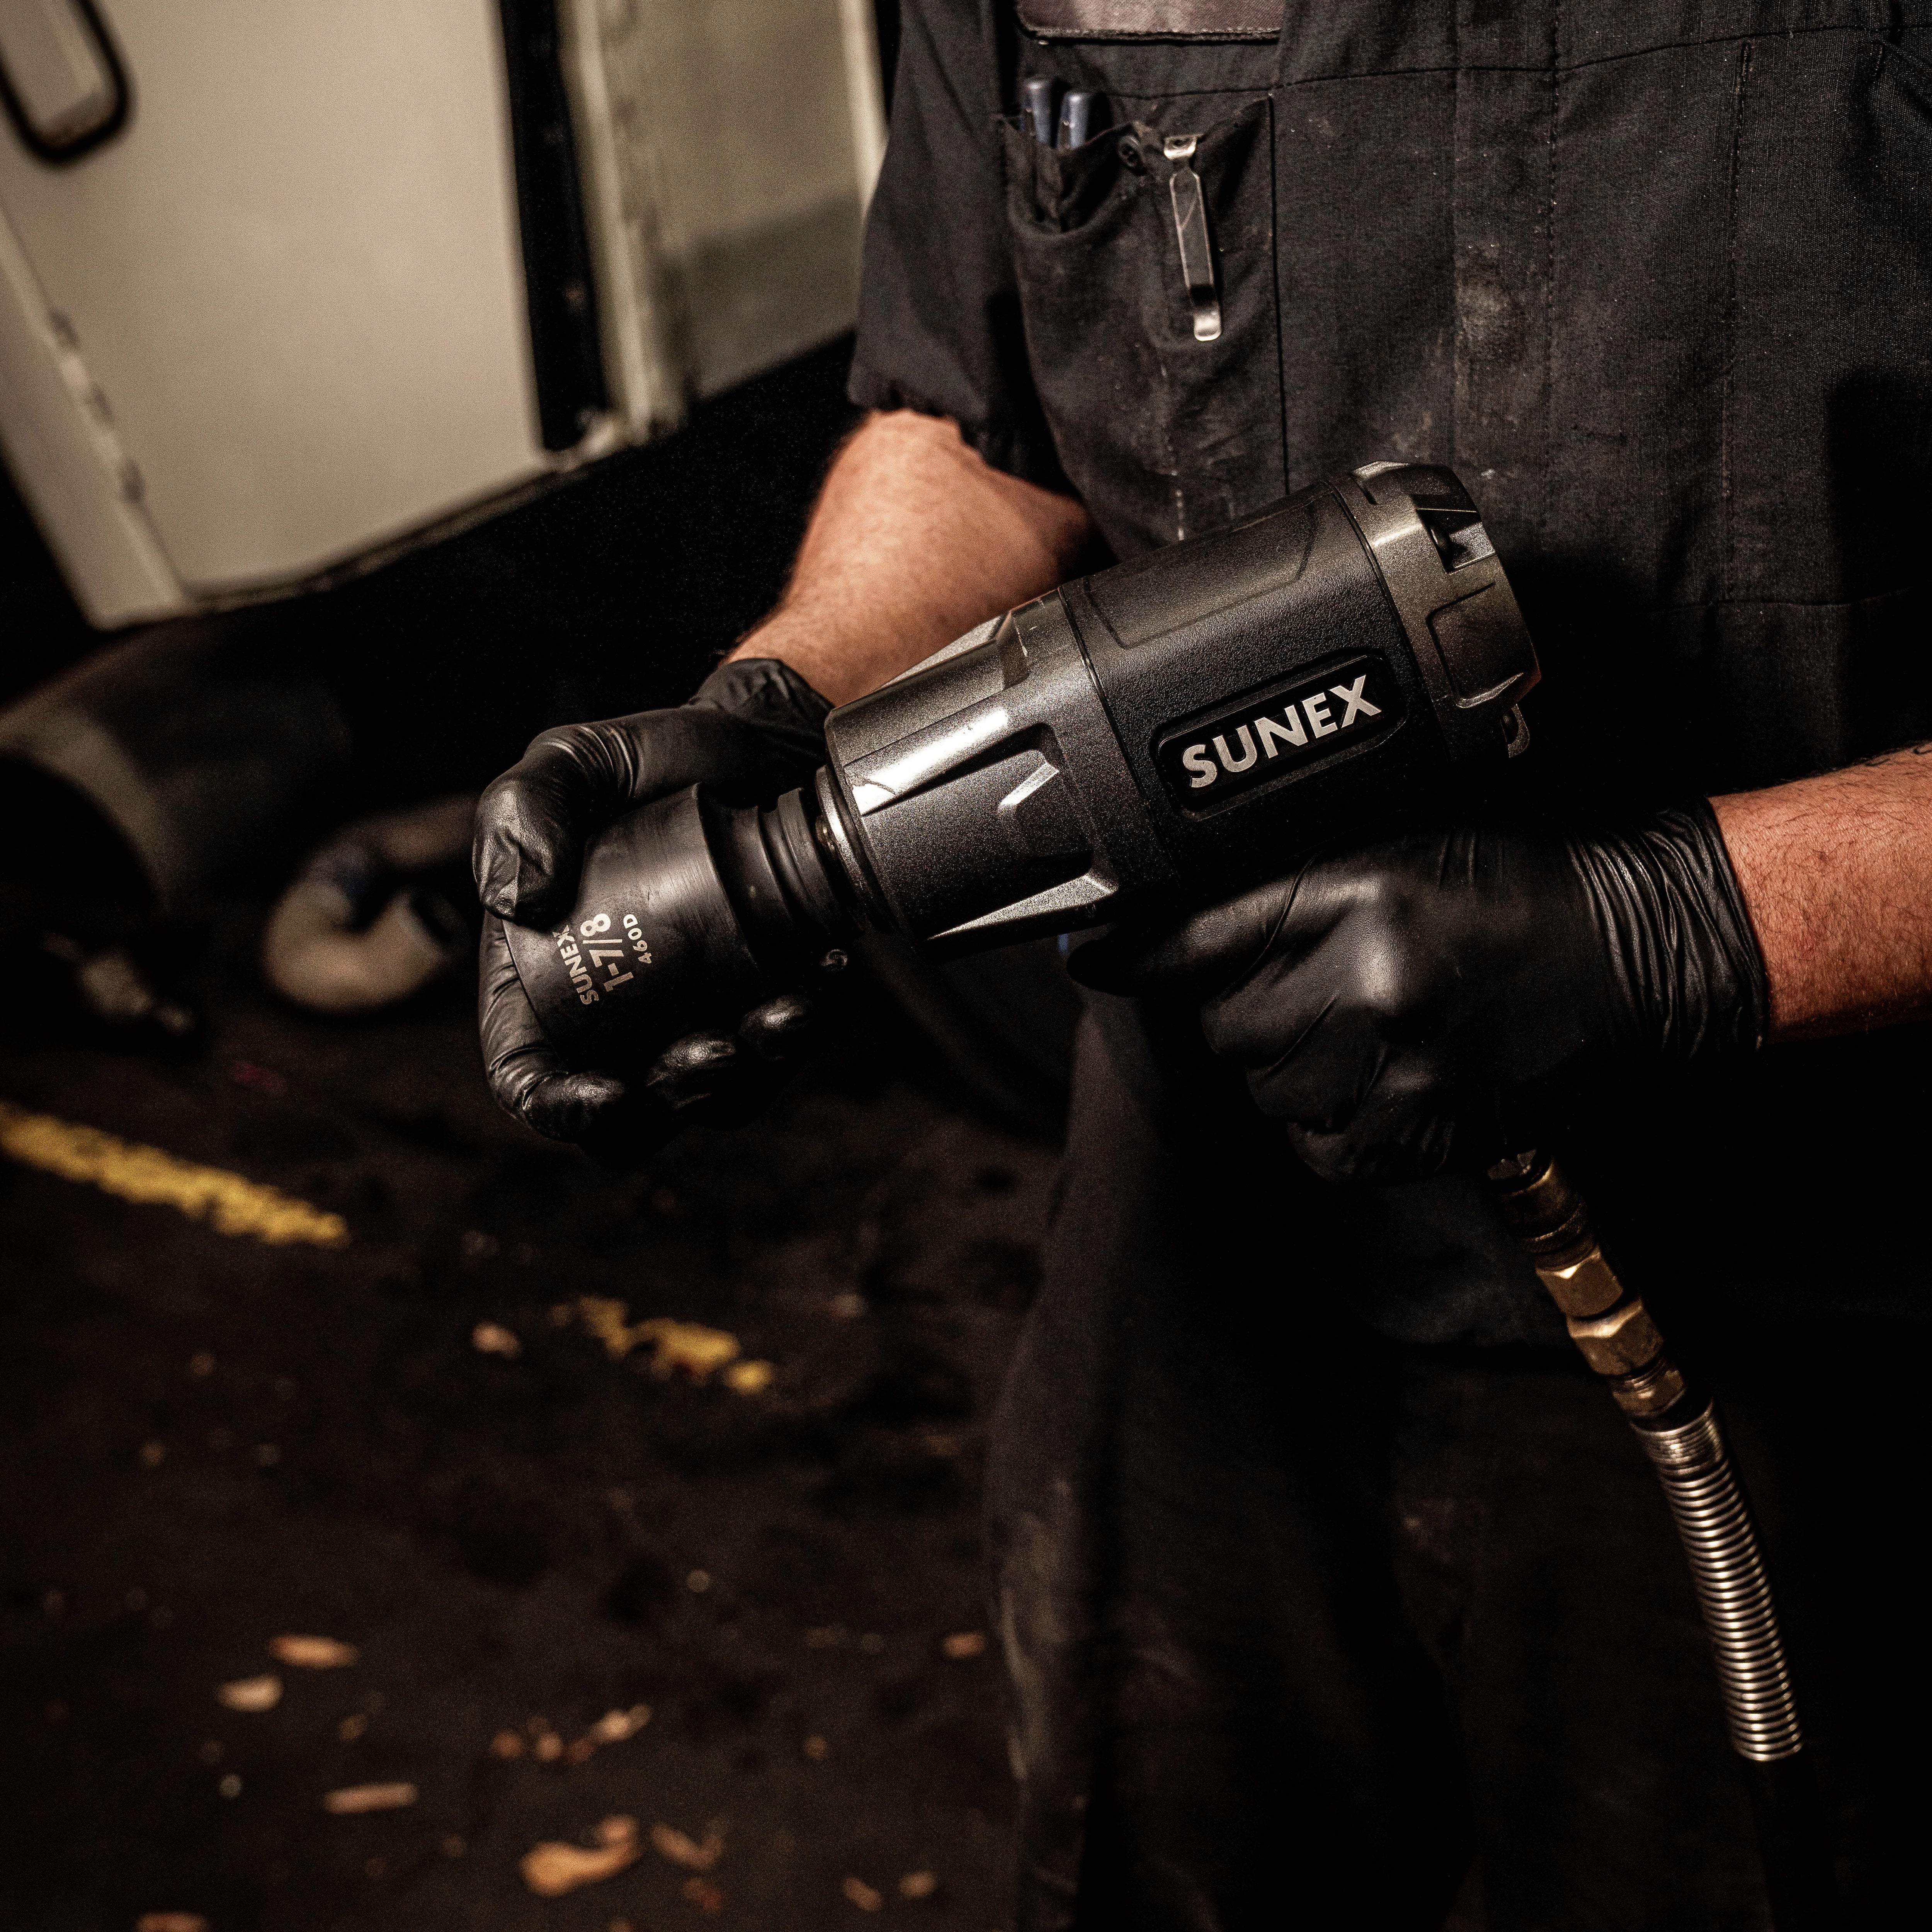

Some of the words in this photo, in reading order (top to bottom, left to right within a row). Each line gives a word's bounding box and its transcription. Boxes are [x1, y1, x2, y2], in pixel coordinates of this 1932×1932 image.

[1182, 674, 1382, 789] SUNEX
[553, 925, 599, 1005] SUNEX
[580, 913, 634, 992] 1-7/8
